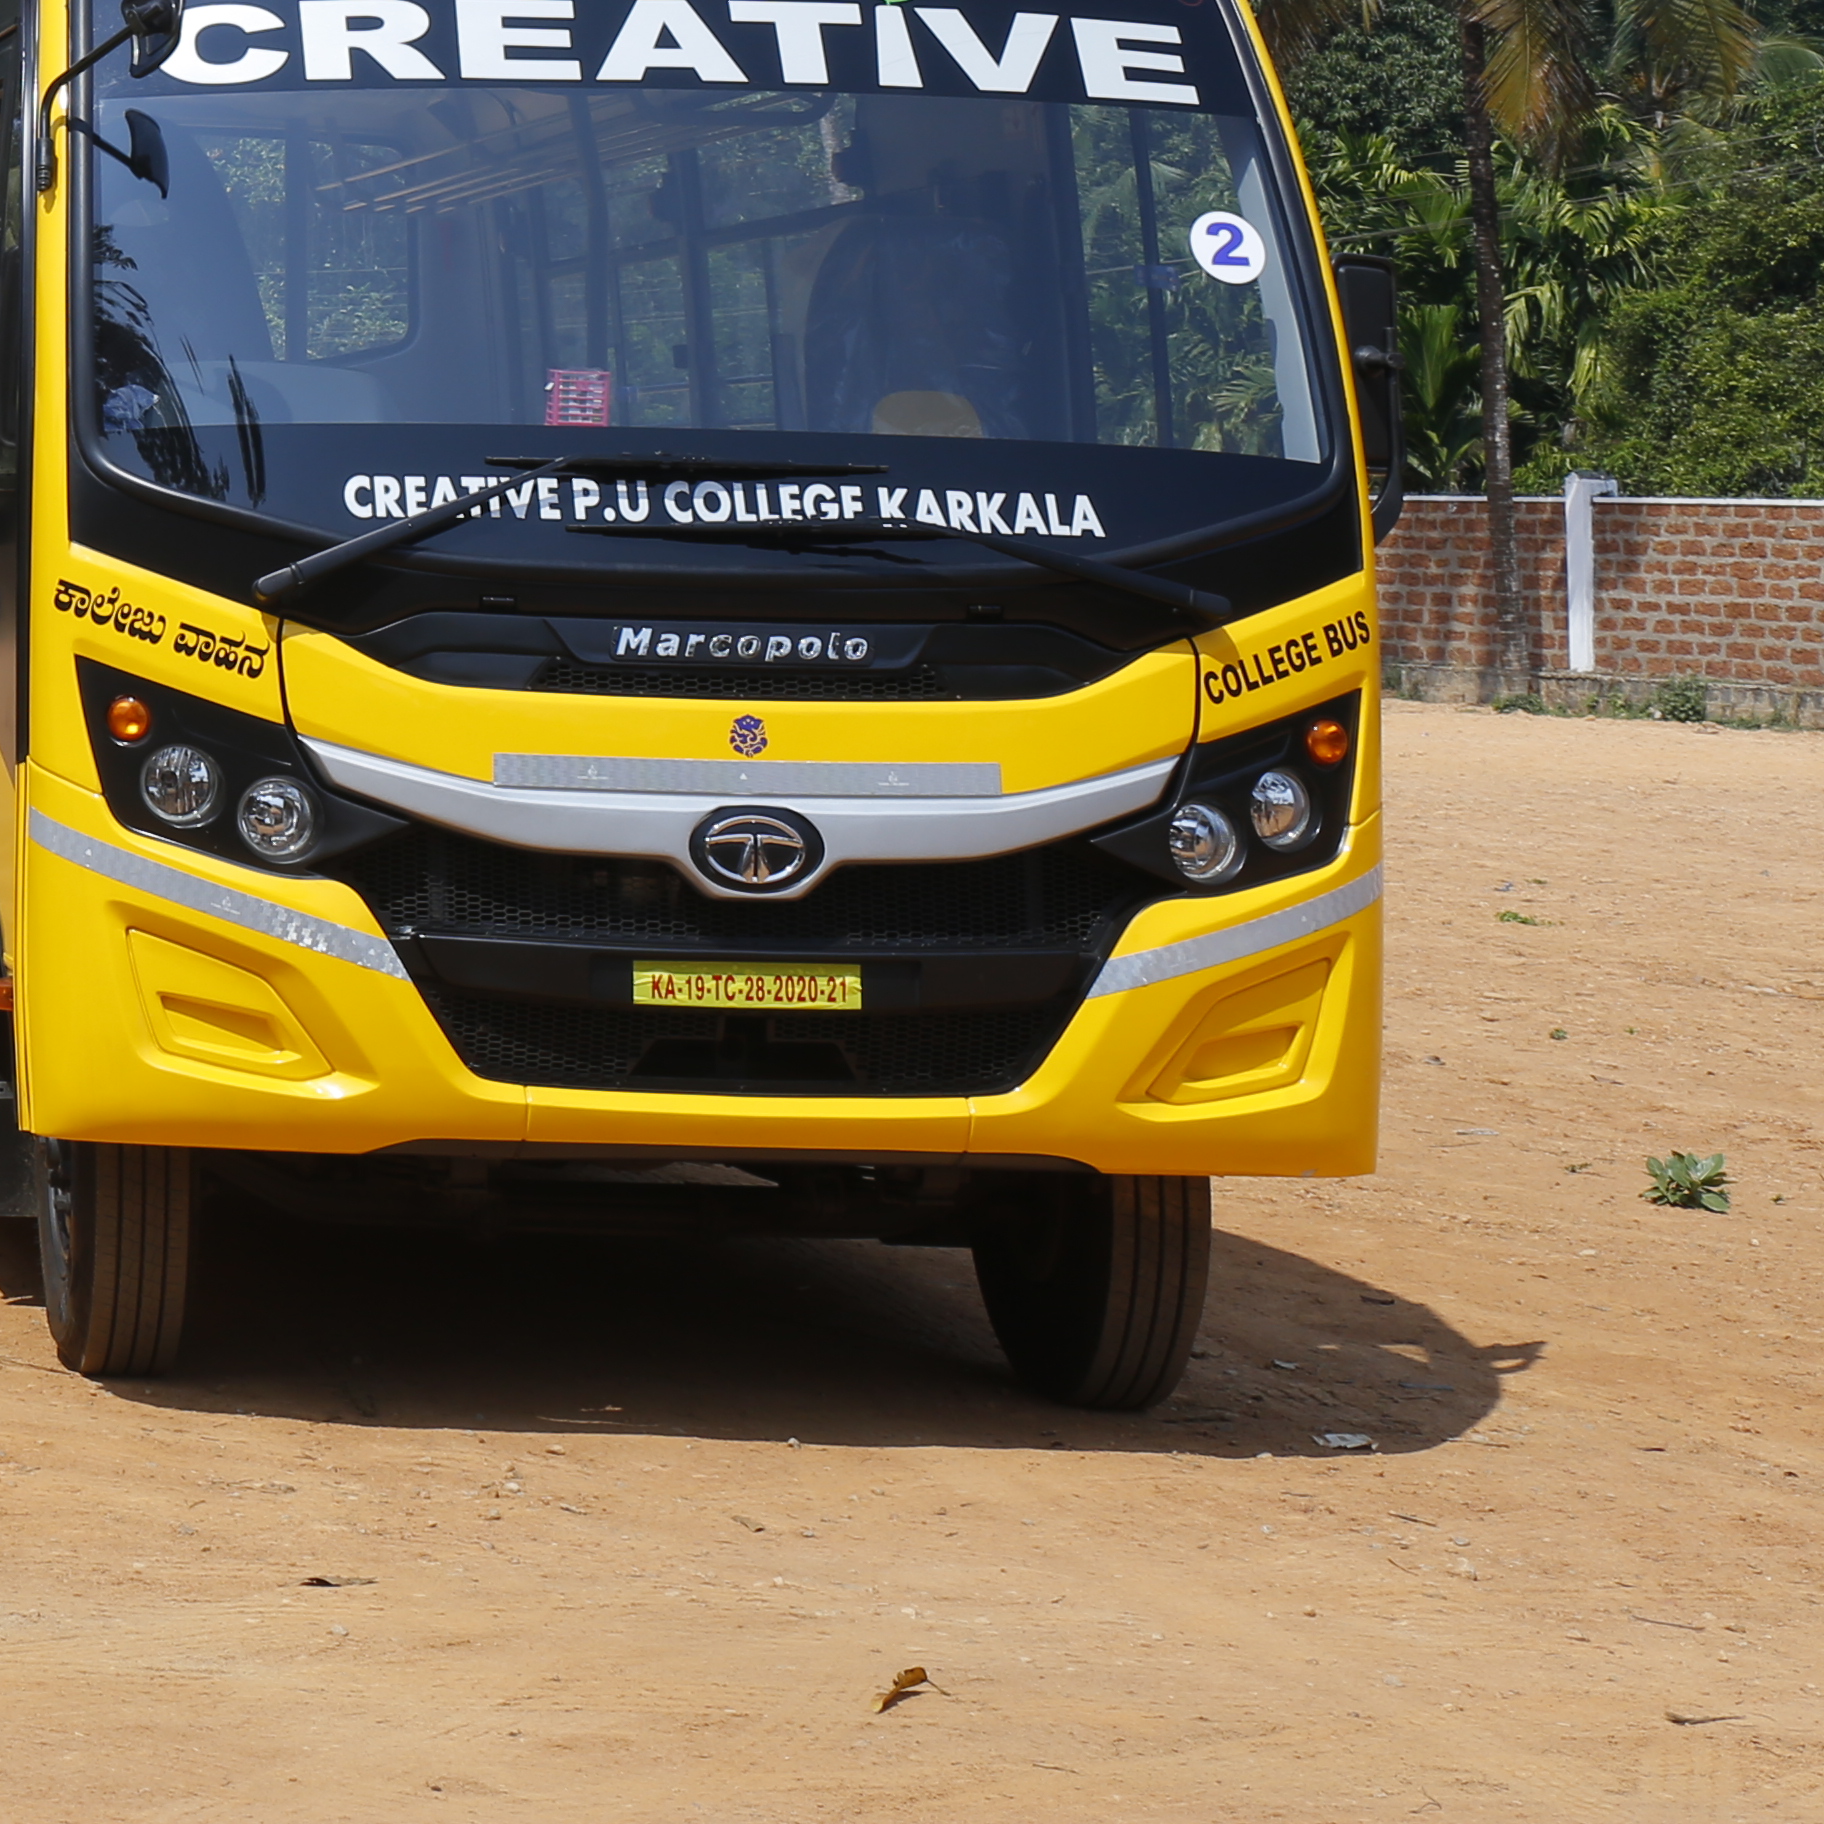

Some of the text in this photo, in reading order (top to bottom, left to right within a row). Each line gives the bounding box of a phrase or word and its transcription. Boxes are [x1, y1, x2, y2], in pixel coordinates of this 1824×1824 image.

[1205, 222, 1251, 267] 2
[343, 475, 1106, 538] CREATIVE P.U COLLEGE KARKALA
[54, 578, 271, 679] ಕಾಲೇಜು ವಾಹನ
[615, 626, 869, 663] Marcopolo
[1203, 610, 1371, 705] COLLEGE BUS
[651, 974, 848, 1003] KA-19-TC-28-2020-21
